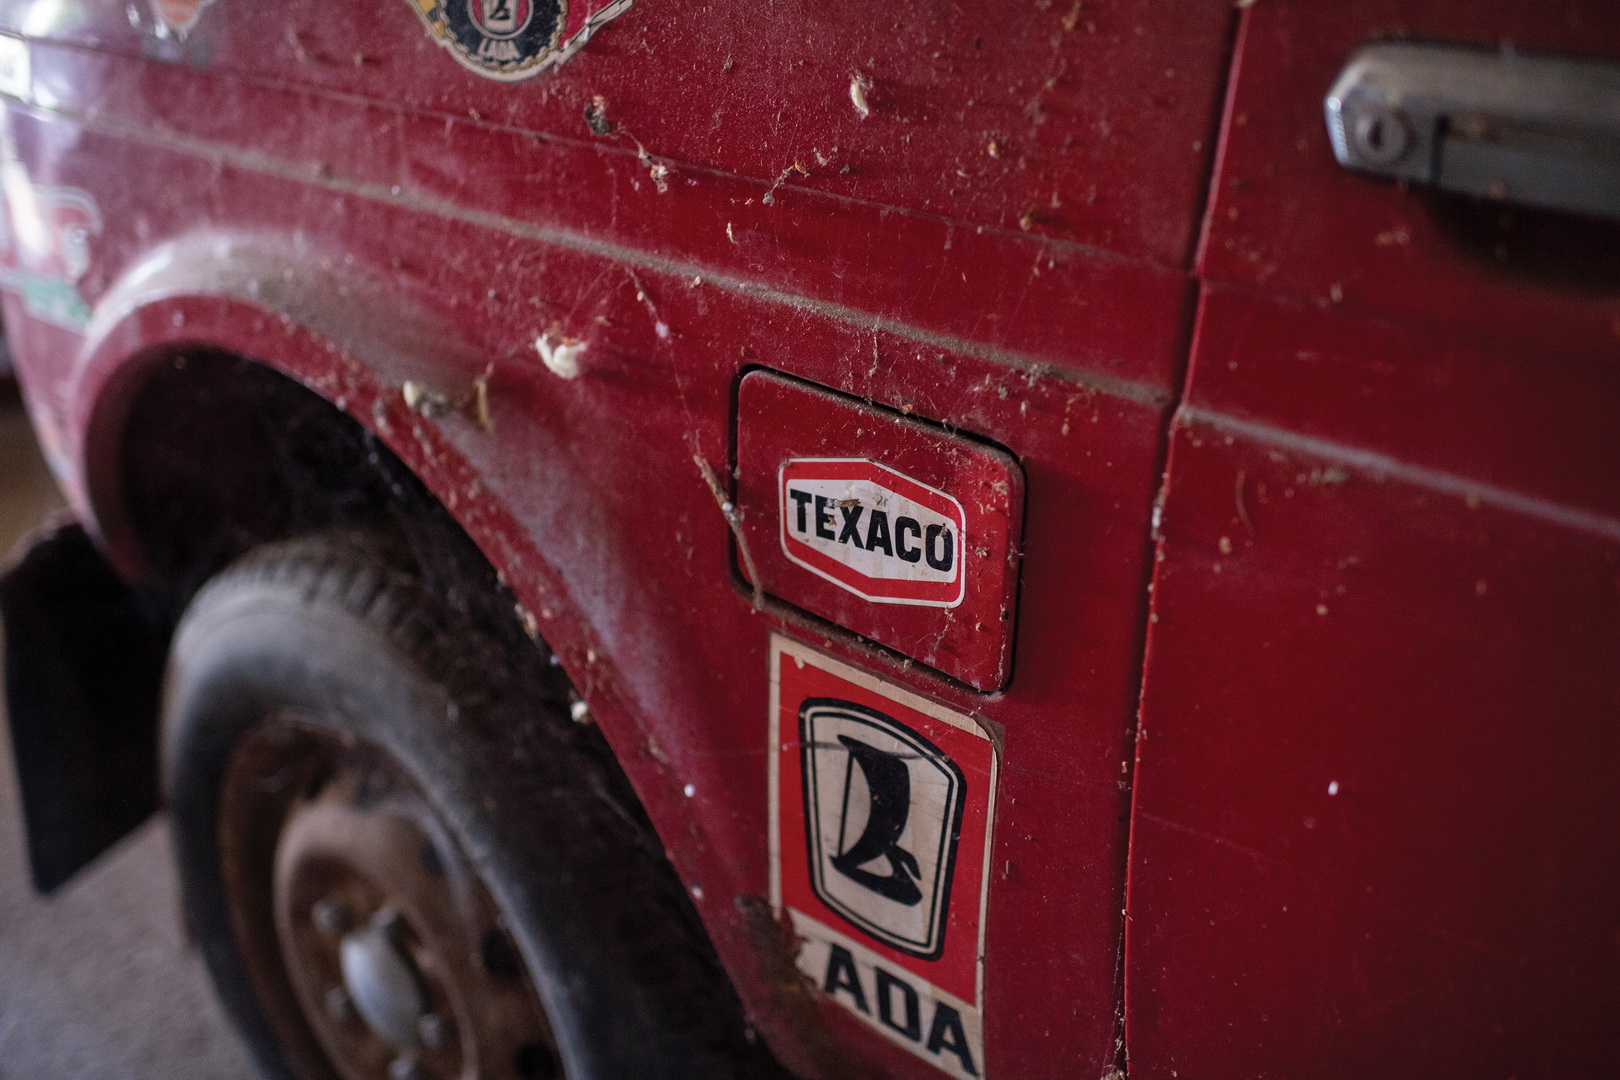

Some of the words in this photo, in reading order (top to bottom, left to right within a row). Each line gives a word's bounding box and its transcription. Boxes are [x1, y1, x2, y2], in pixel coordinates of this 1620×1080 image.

[477, 37, 522, 60] LADA
[789, 488, 954, 573] TEXACO
[823, 942, 981, 1079] ADA
